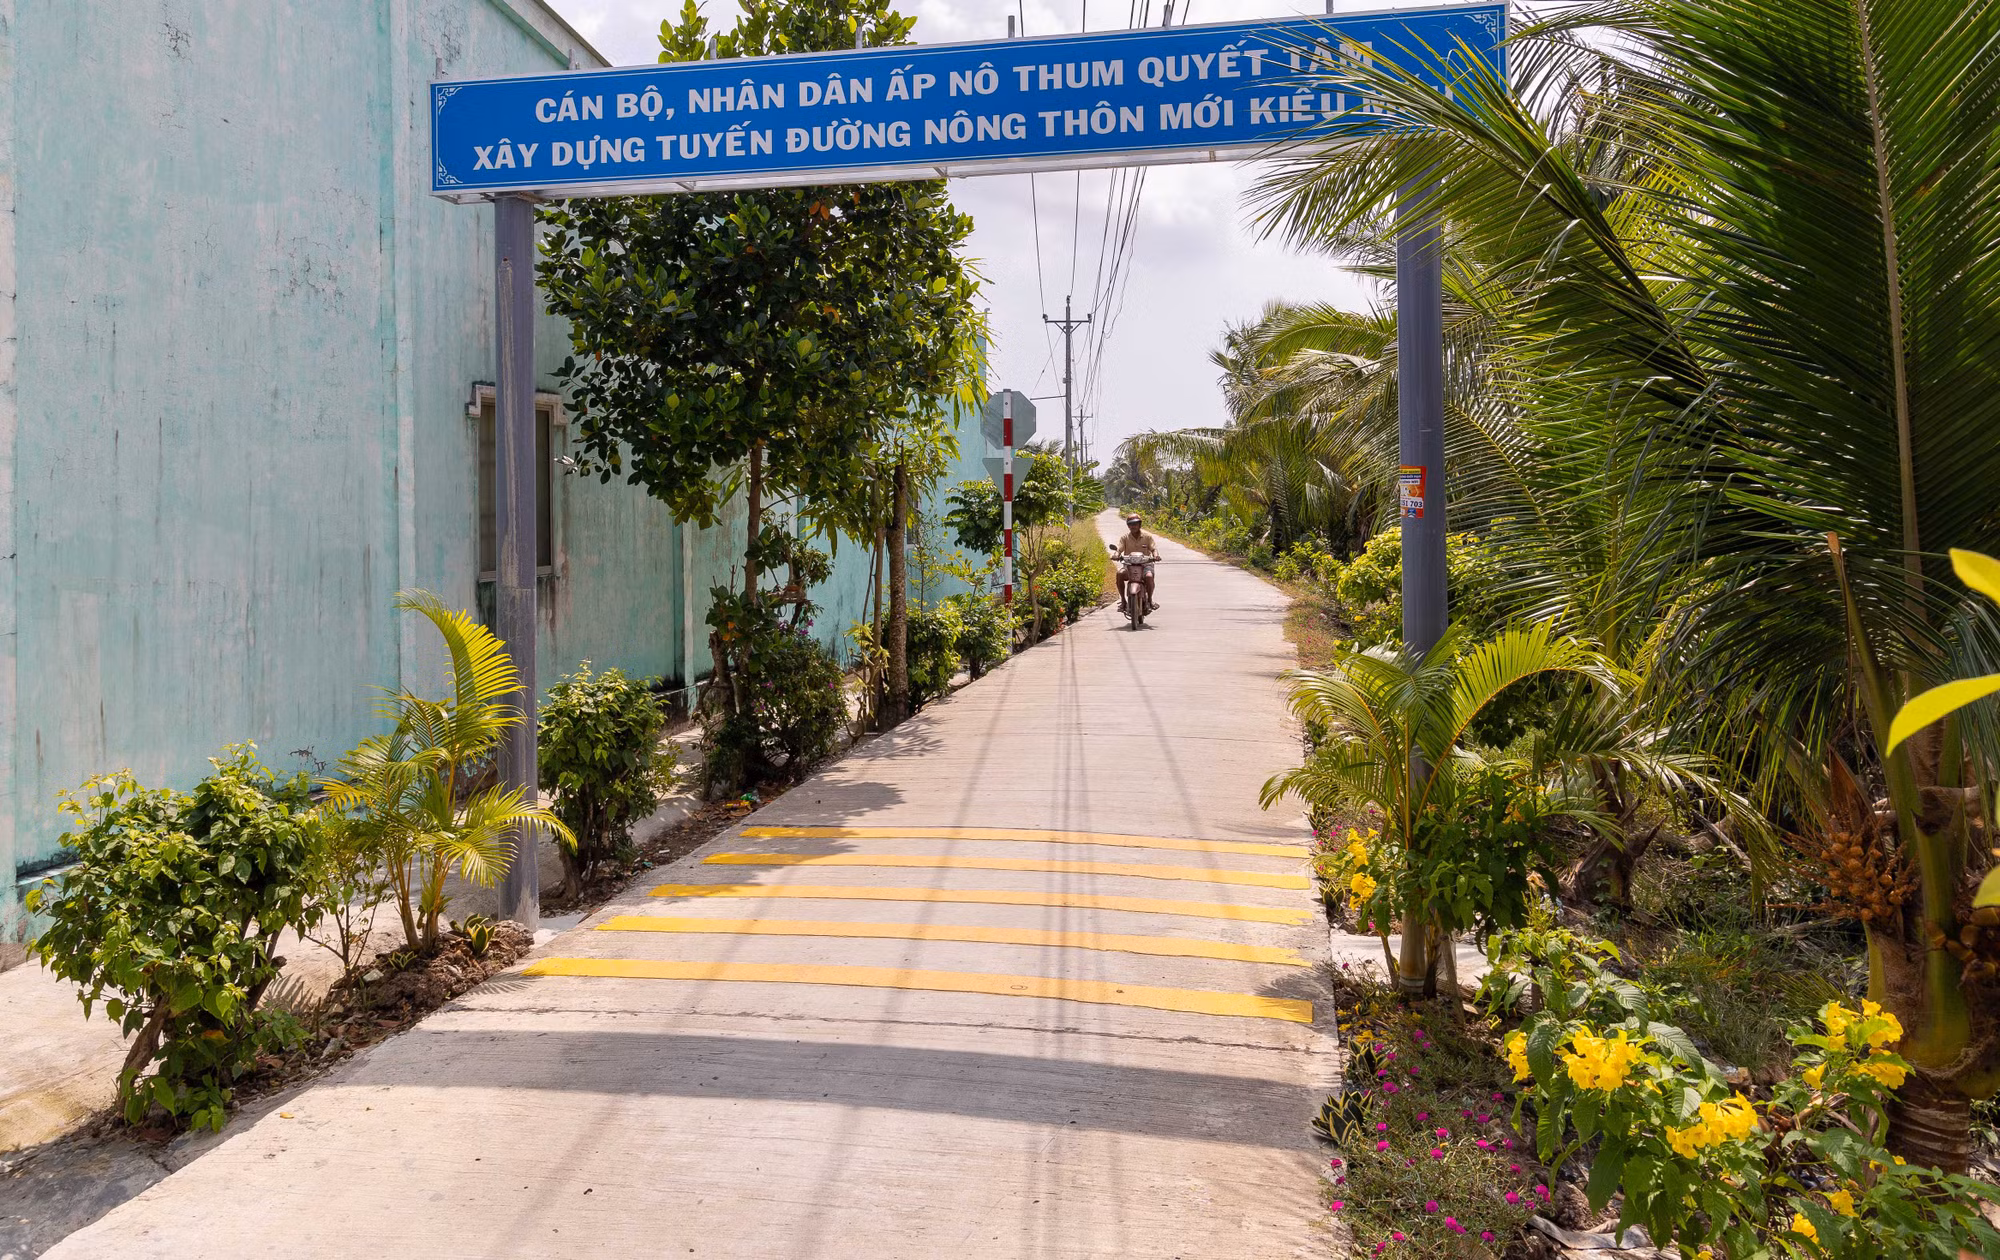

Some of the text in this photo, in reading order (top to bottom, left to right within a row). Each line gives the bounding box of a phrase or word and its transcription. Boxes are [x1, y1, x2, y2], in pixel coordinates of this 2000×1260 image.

[536, 37, 1372, 122] CÁN BỘ, NHÂN DÂN ẤP NÔ THUM QUYẾT TÂM
[473, 138, 538, 170] XÂY
[552, 135, 644, 170] DỰNG
[656, 121, 772, 160] TUYẾN
[786, 118, 910, 152] ĐƯỜNG
[925, 110, 1025, 144] NÔNG
[1039, 101, 1143, 136] THÔN
[1160, 94, 1233, 129] MỚI
